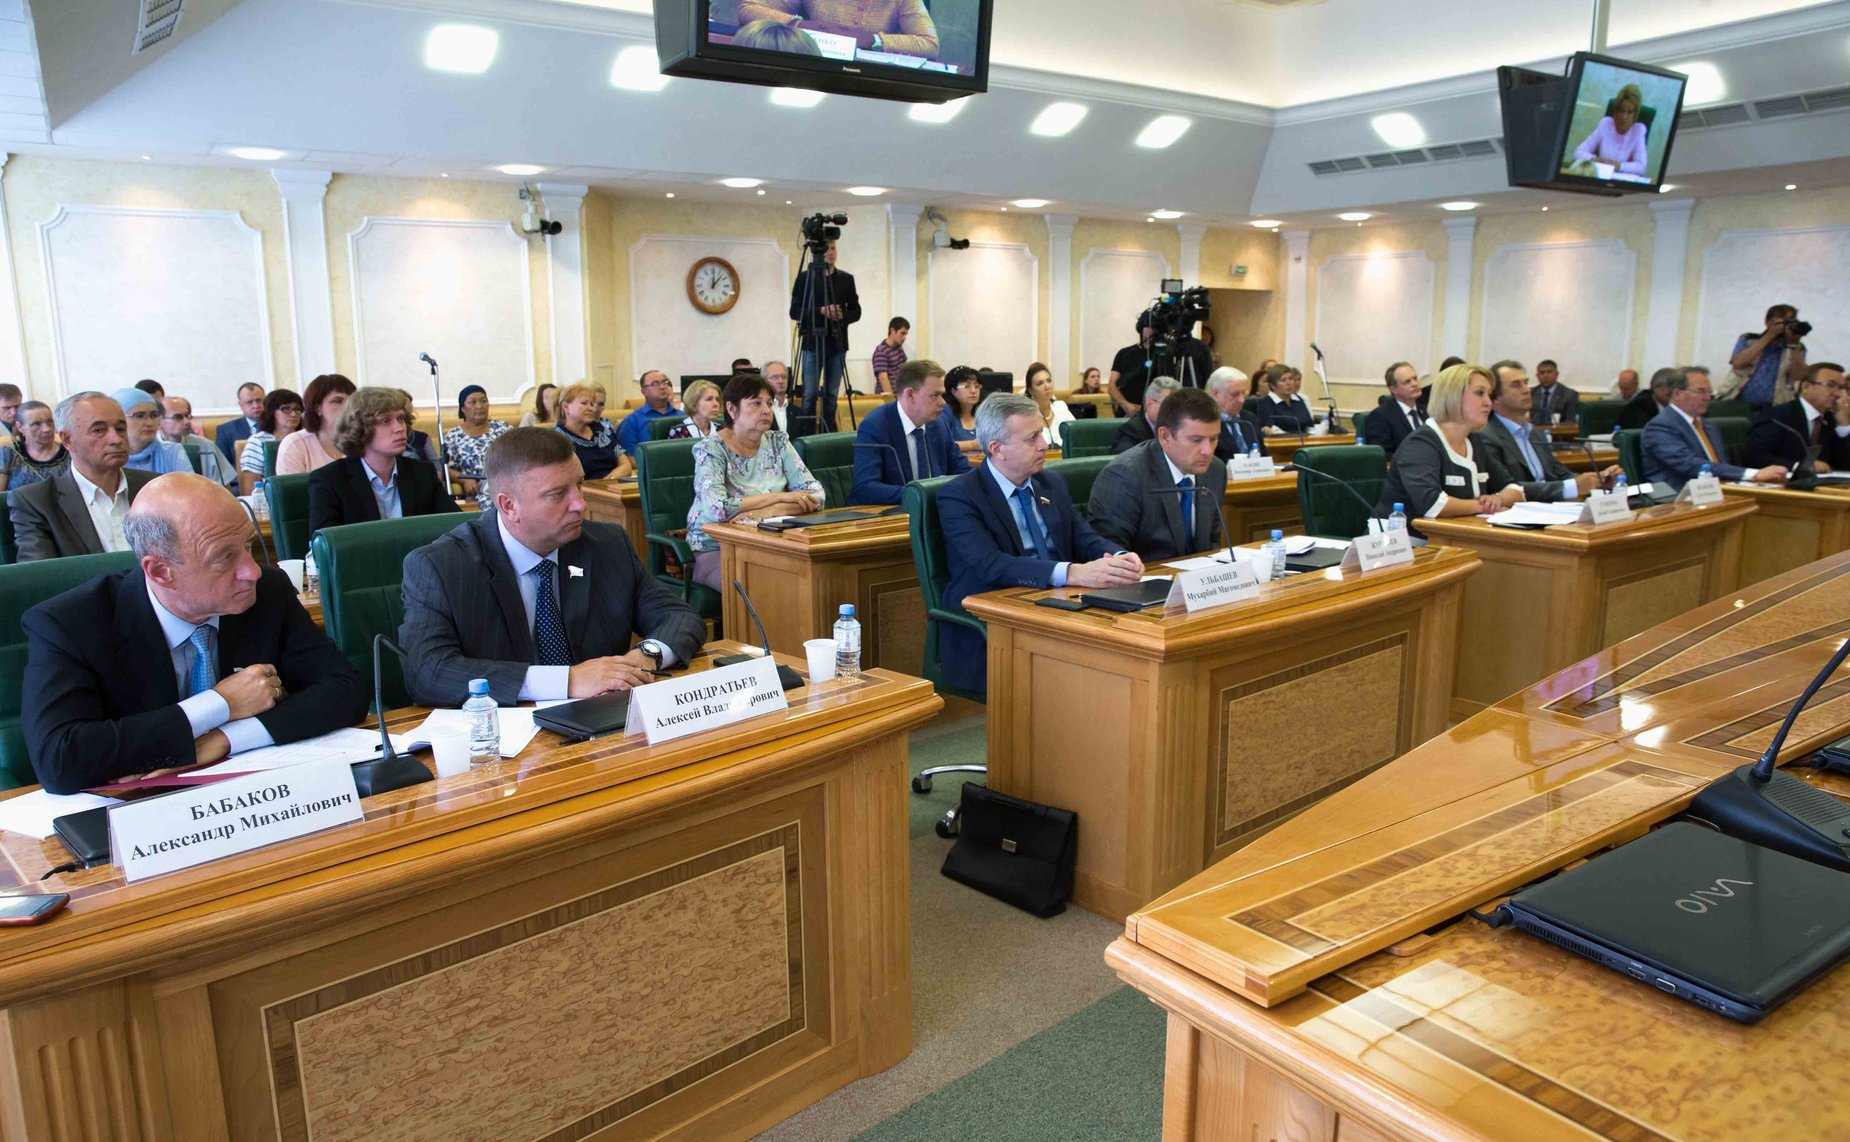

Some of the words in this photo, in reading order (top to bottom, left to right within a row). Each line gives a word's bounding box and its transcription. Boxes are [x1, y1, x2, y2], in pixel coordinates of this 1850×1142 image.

[1186, 588, 1218, 602] Мухарбий
[1217, 580, 1256, 594] Магомедович
[1200, 571, 1238, 586] УЛЬБАШЕВ
[674, 676, 758, 706] КОНДРАТЬЕВ
[656, 707, 702, 729] Алексей
[190, 783, 291, 821] БАБАКОВ
[131, 823, 235, 860] Александр
[240, 792, 353, 832] Михайлович
[1674, 878, 1754, 914] VAIO
